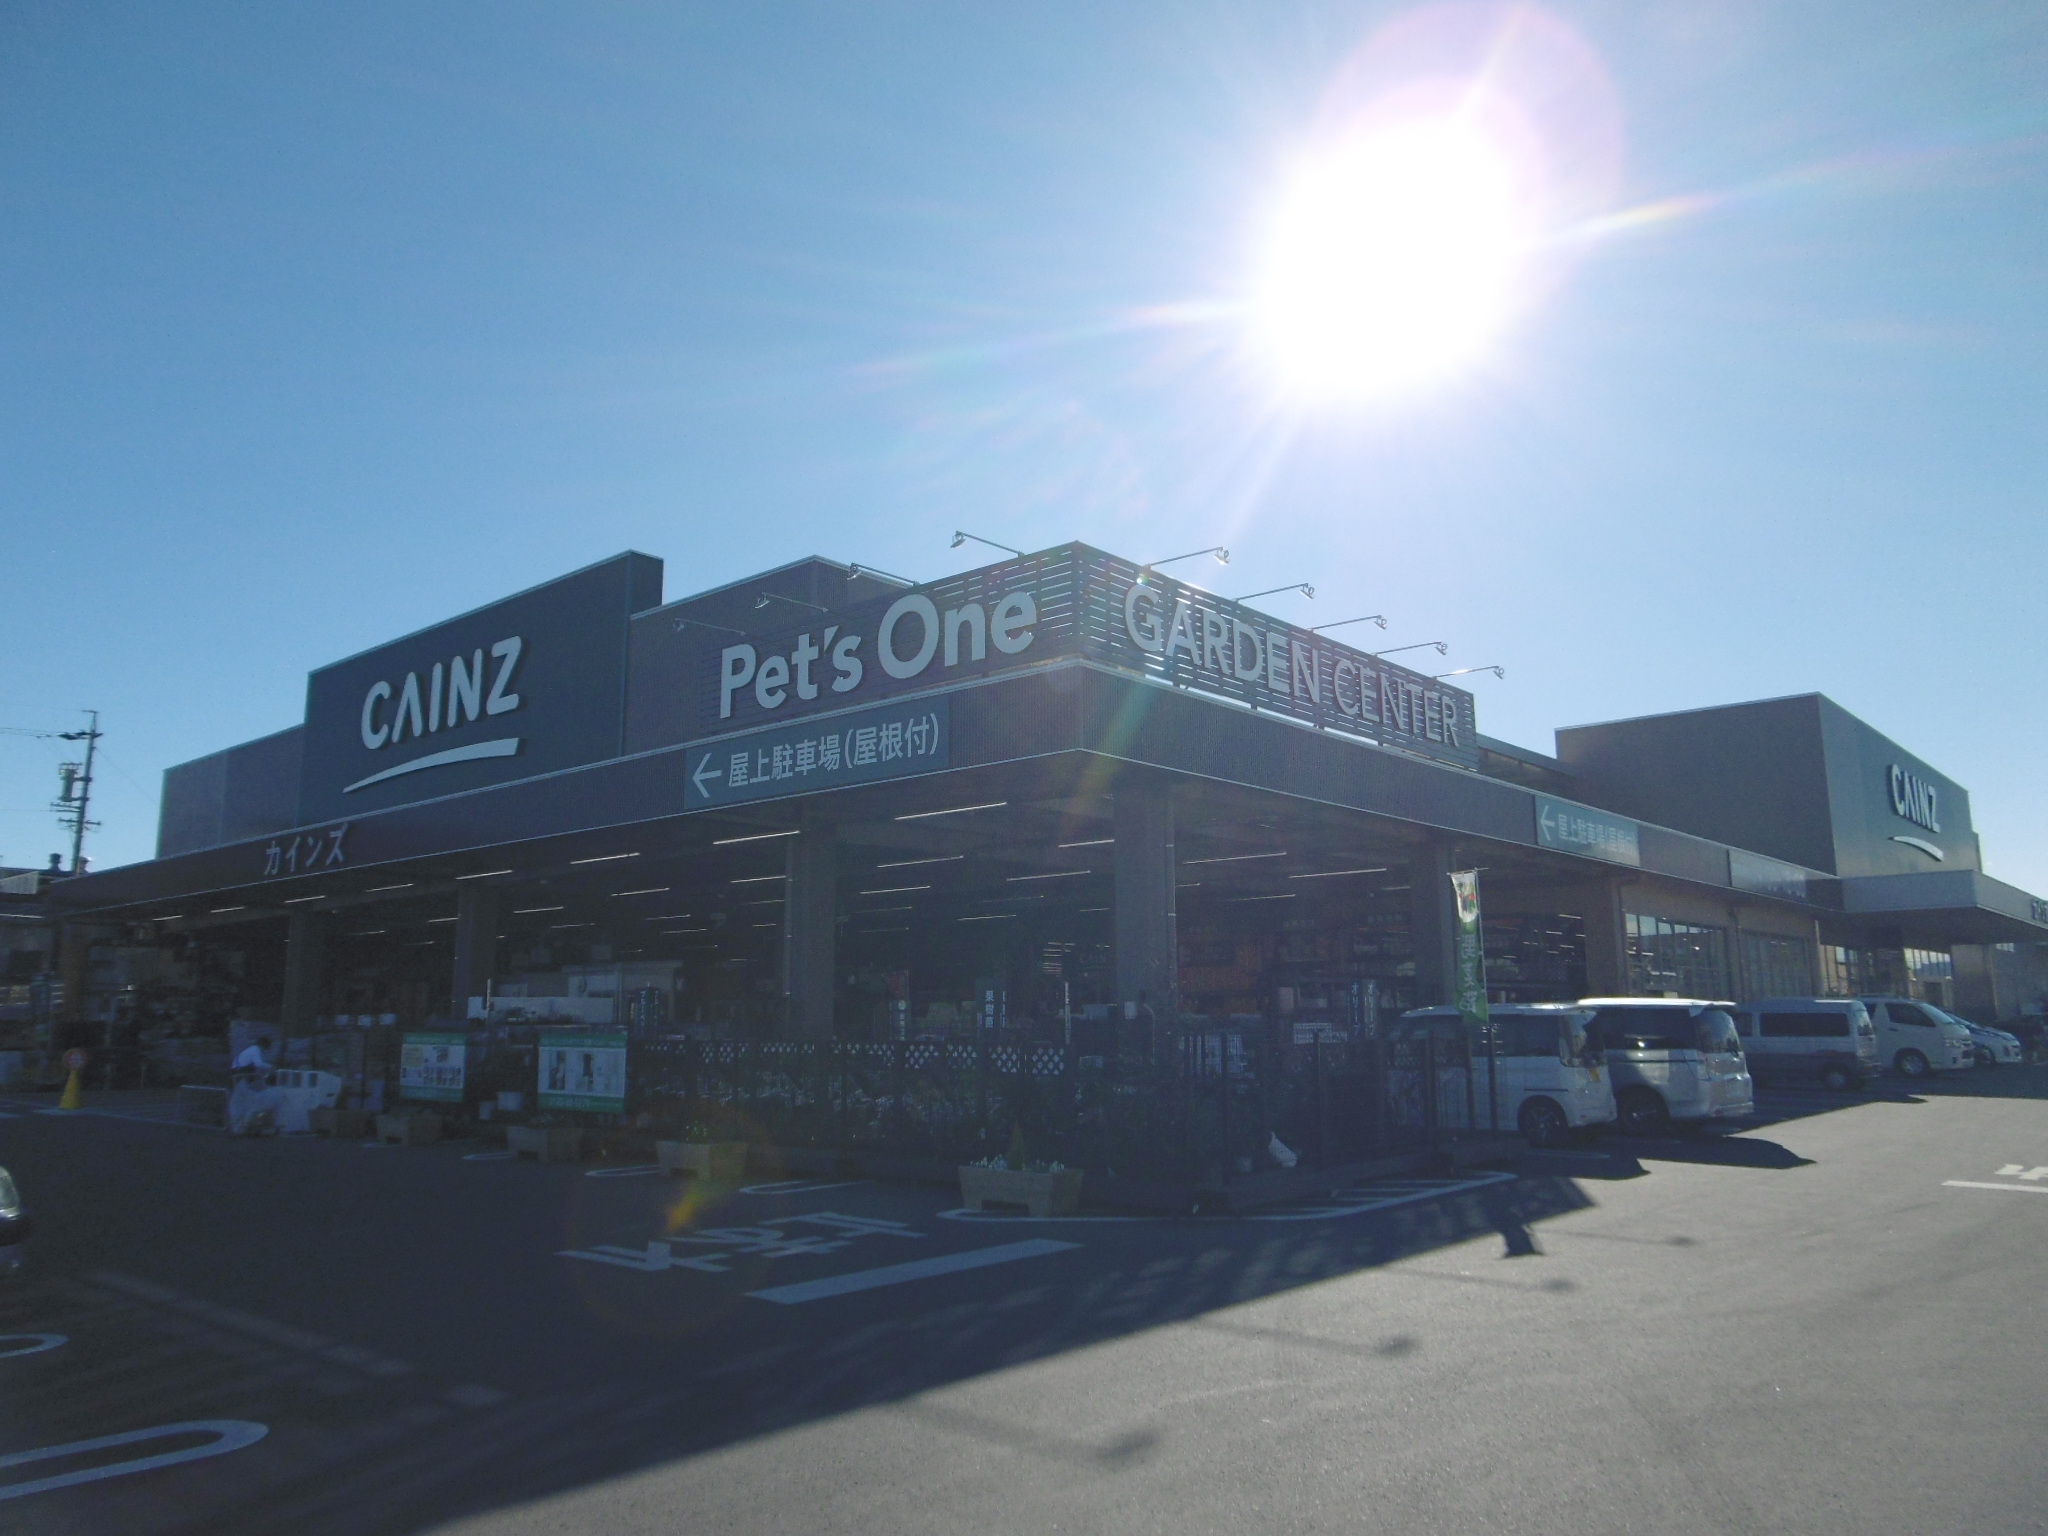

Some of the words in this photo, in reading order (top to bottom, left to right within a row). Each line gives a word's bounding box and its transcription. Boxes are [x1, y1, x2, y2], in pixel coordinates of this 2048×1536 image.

[361, 635, 522, 750] CAINZ
[720, 625, 863, 718] Pet's
[877, 592, 1037, 679] One
[1124, 584, 1320, 703] GARDEN
[1333, 658, 1459, 748] CENTER
[728, 713, 939, 788] 屋上駐車場(屋根付)
[1891, 763, 1941, 834] CAINZ
